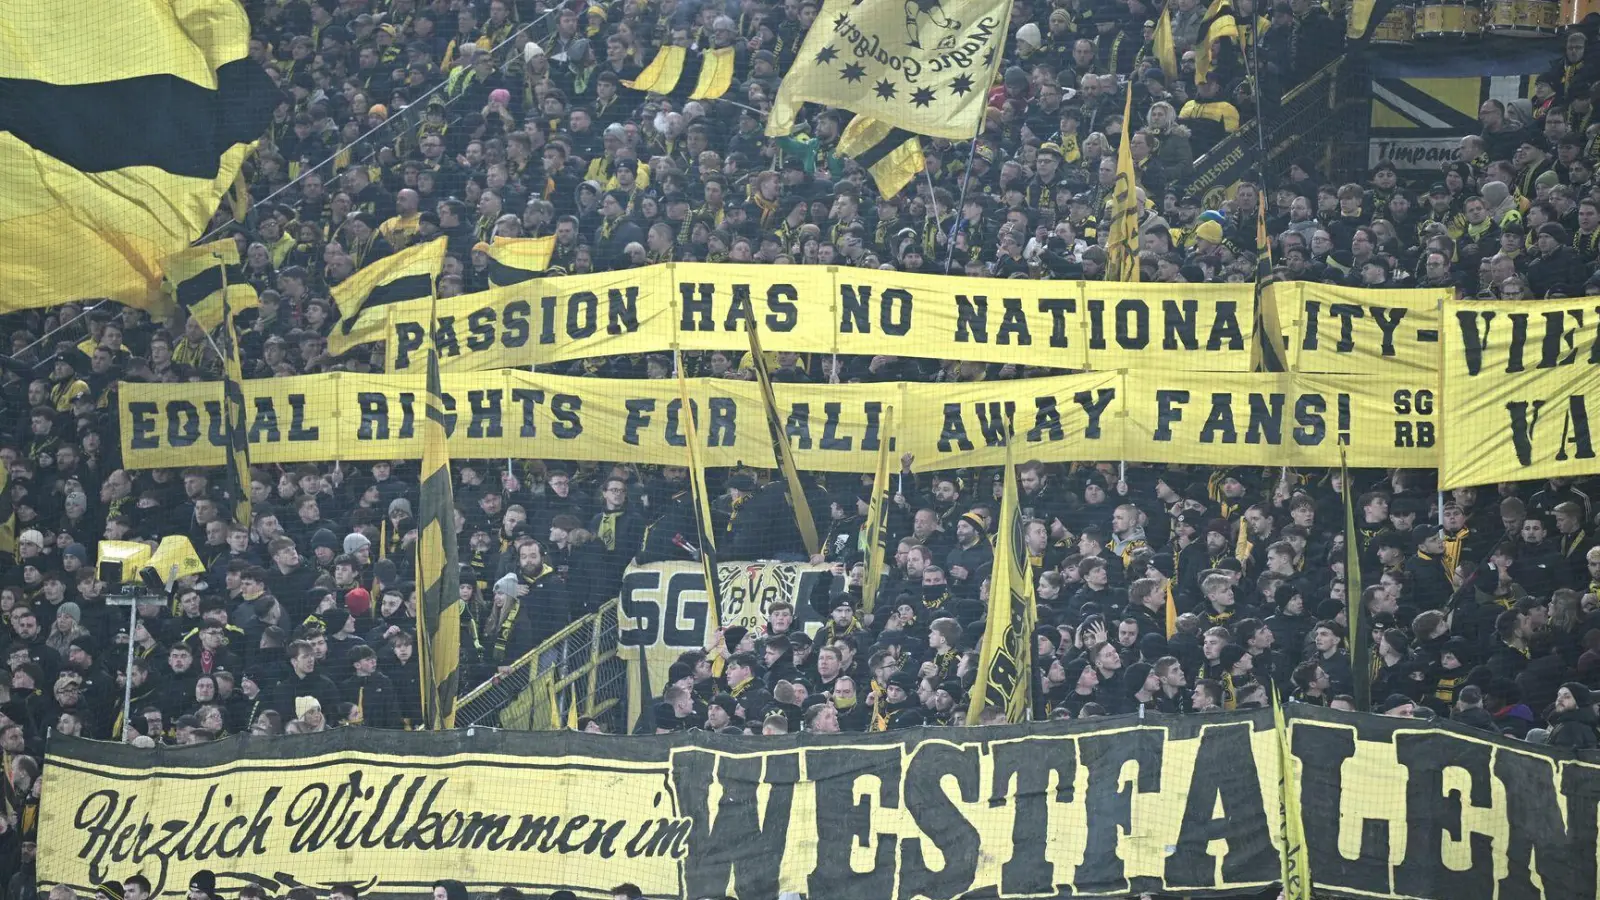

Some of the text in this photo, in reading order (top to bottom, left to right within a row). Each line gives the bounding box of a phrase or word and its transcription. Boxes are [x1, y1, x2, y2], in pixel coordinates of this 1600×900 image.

[395, 283, 1439, 370] PASSION HAS NO NATIONAITY-
[1456, 306, 1600, 376] VIE
[623, 397, 737, 448] FOR
[785, 402, 896, 451] ALL
[937, 388, 1115, 452] AWAY
[1153, 389, 1350, 445] FANS!
[1393, 389, 1434, 415] SG
[1394, 421, 1436, 447] RB
[1505, 395, 1597, 466] VA
[619, 571, 710, 648] SG
[729, 573, 780, 617] BVB
[740, 616, 757, 628] 09
[74, 783, 283, 898] Herzlich
[284, 769, 627, 859] Willkommen
[624, 791, 692, 860] im
